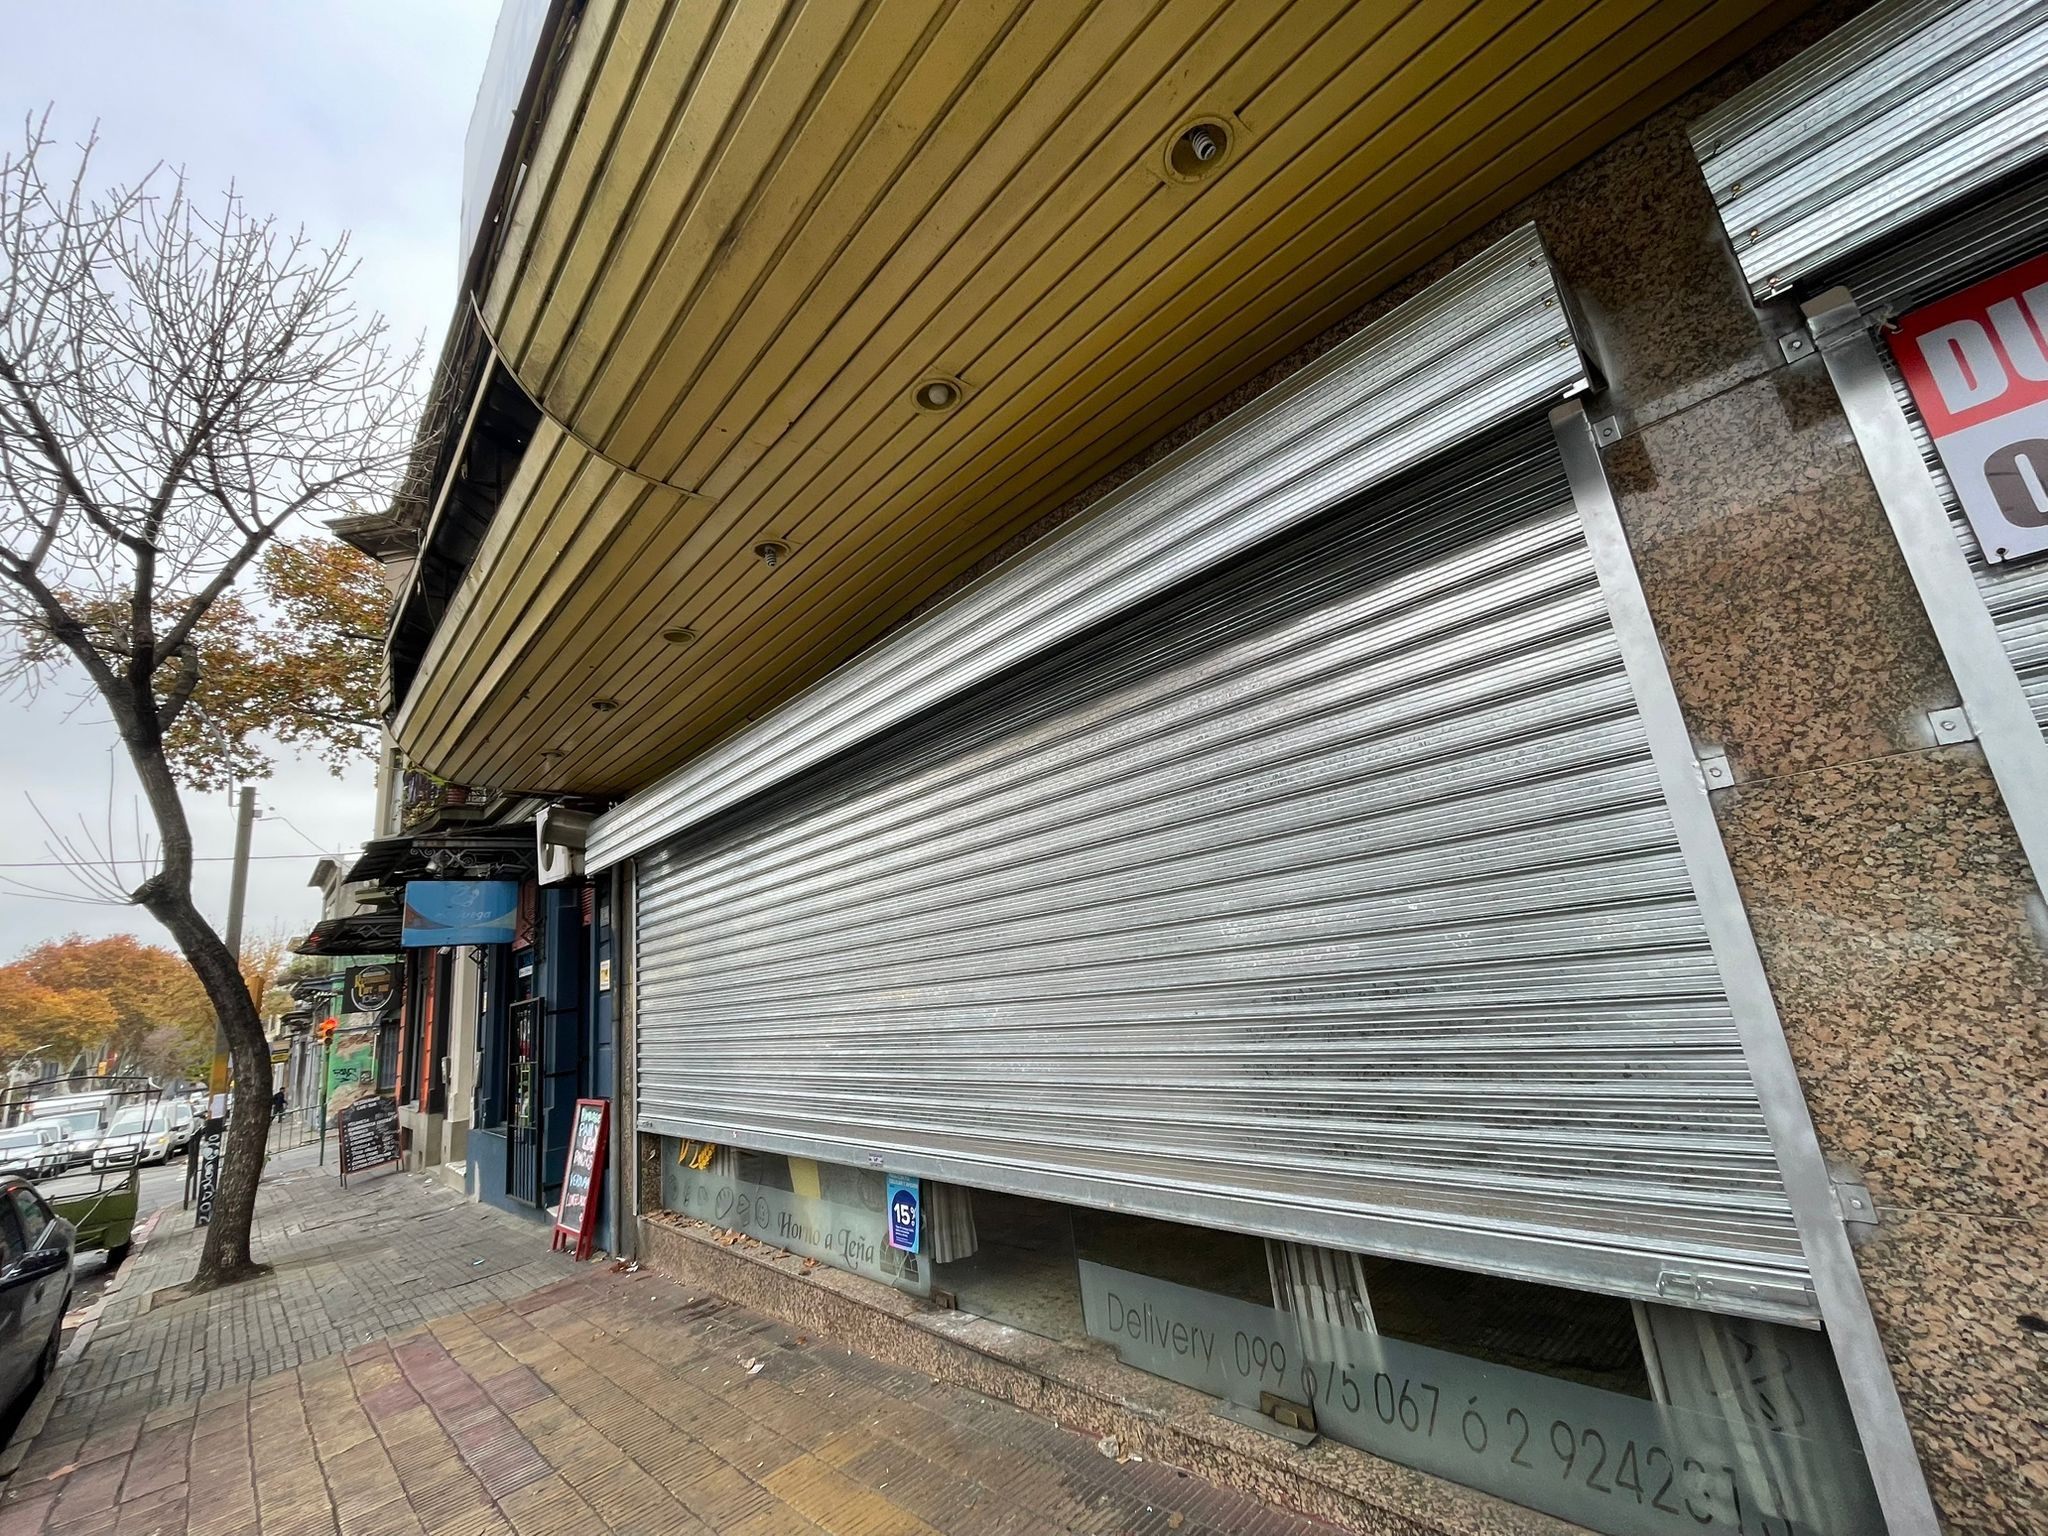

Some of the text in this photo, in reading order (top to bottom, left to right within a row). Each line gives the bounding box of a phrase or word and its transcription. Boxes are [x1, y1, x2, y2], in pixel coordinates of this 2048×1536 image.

[778, 1212, 821, 1247] Horno
[825, 1232, 834, 1251] a
[838, 1229, 877, 1271] Leña
[1107, 1293, 1215, 1366] Delivery
[1233, 1331, 1288, 1388] 099
[1374, 1372, 1441, 1438] 067
[1462, 1396, 1488, 1454] ó
[1507, 1408, 1533, 1469] 2
